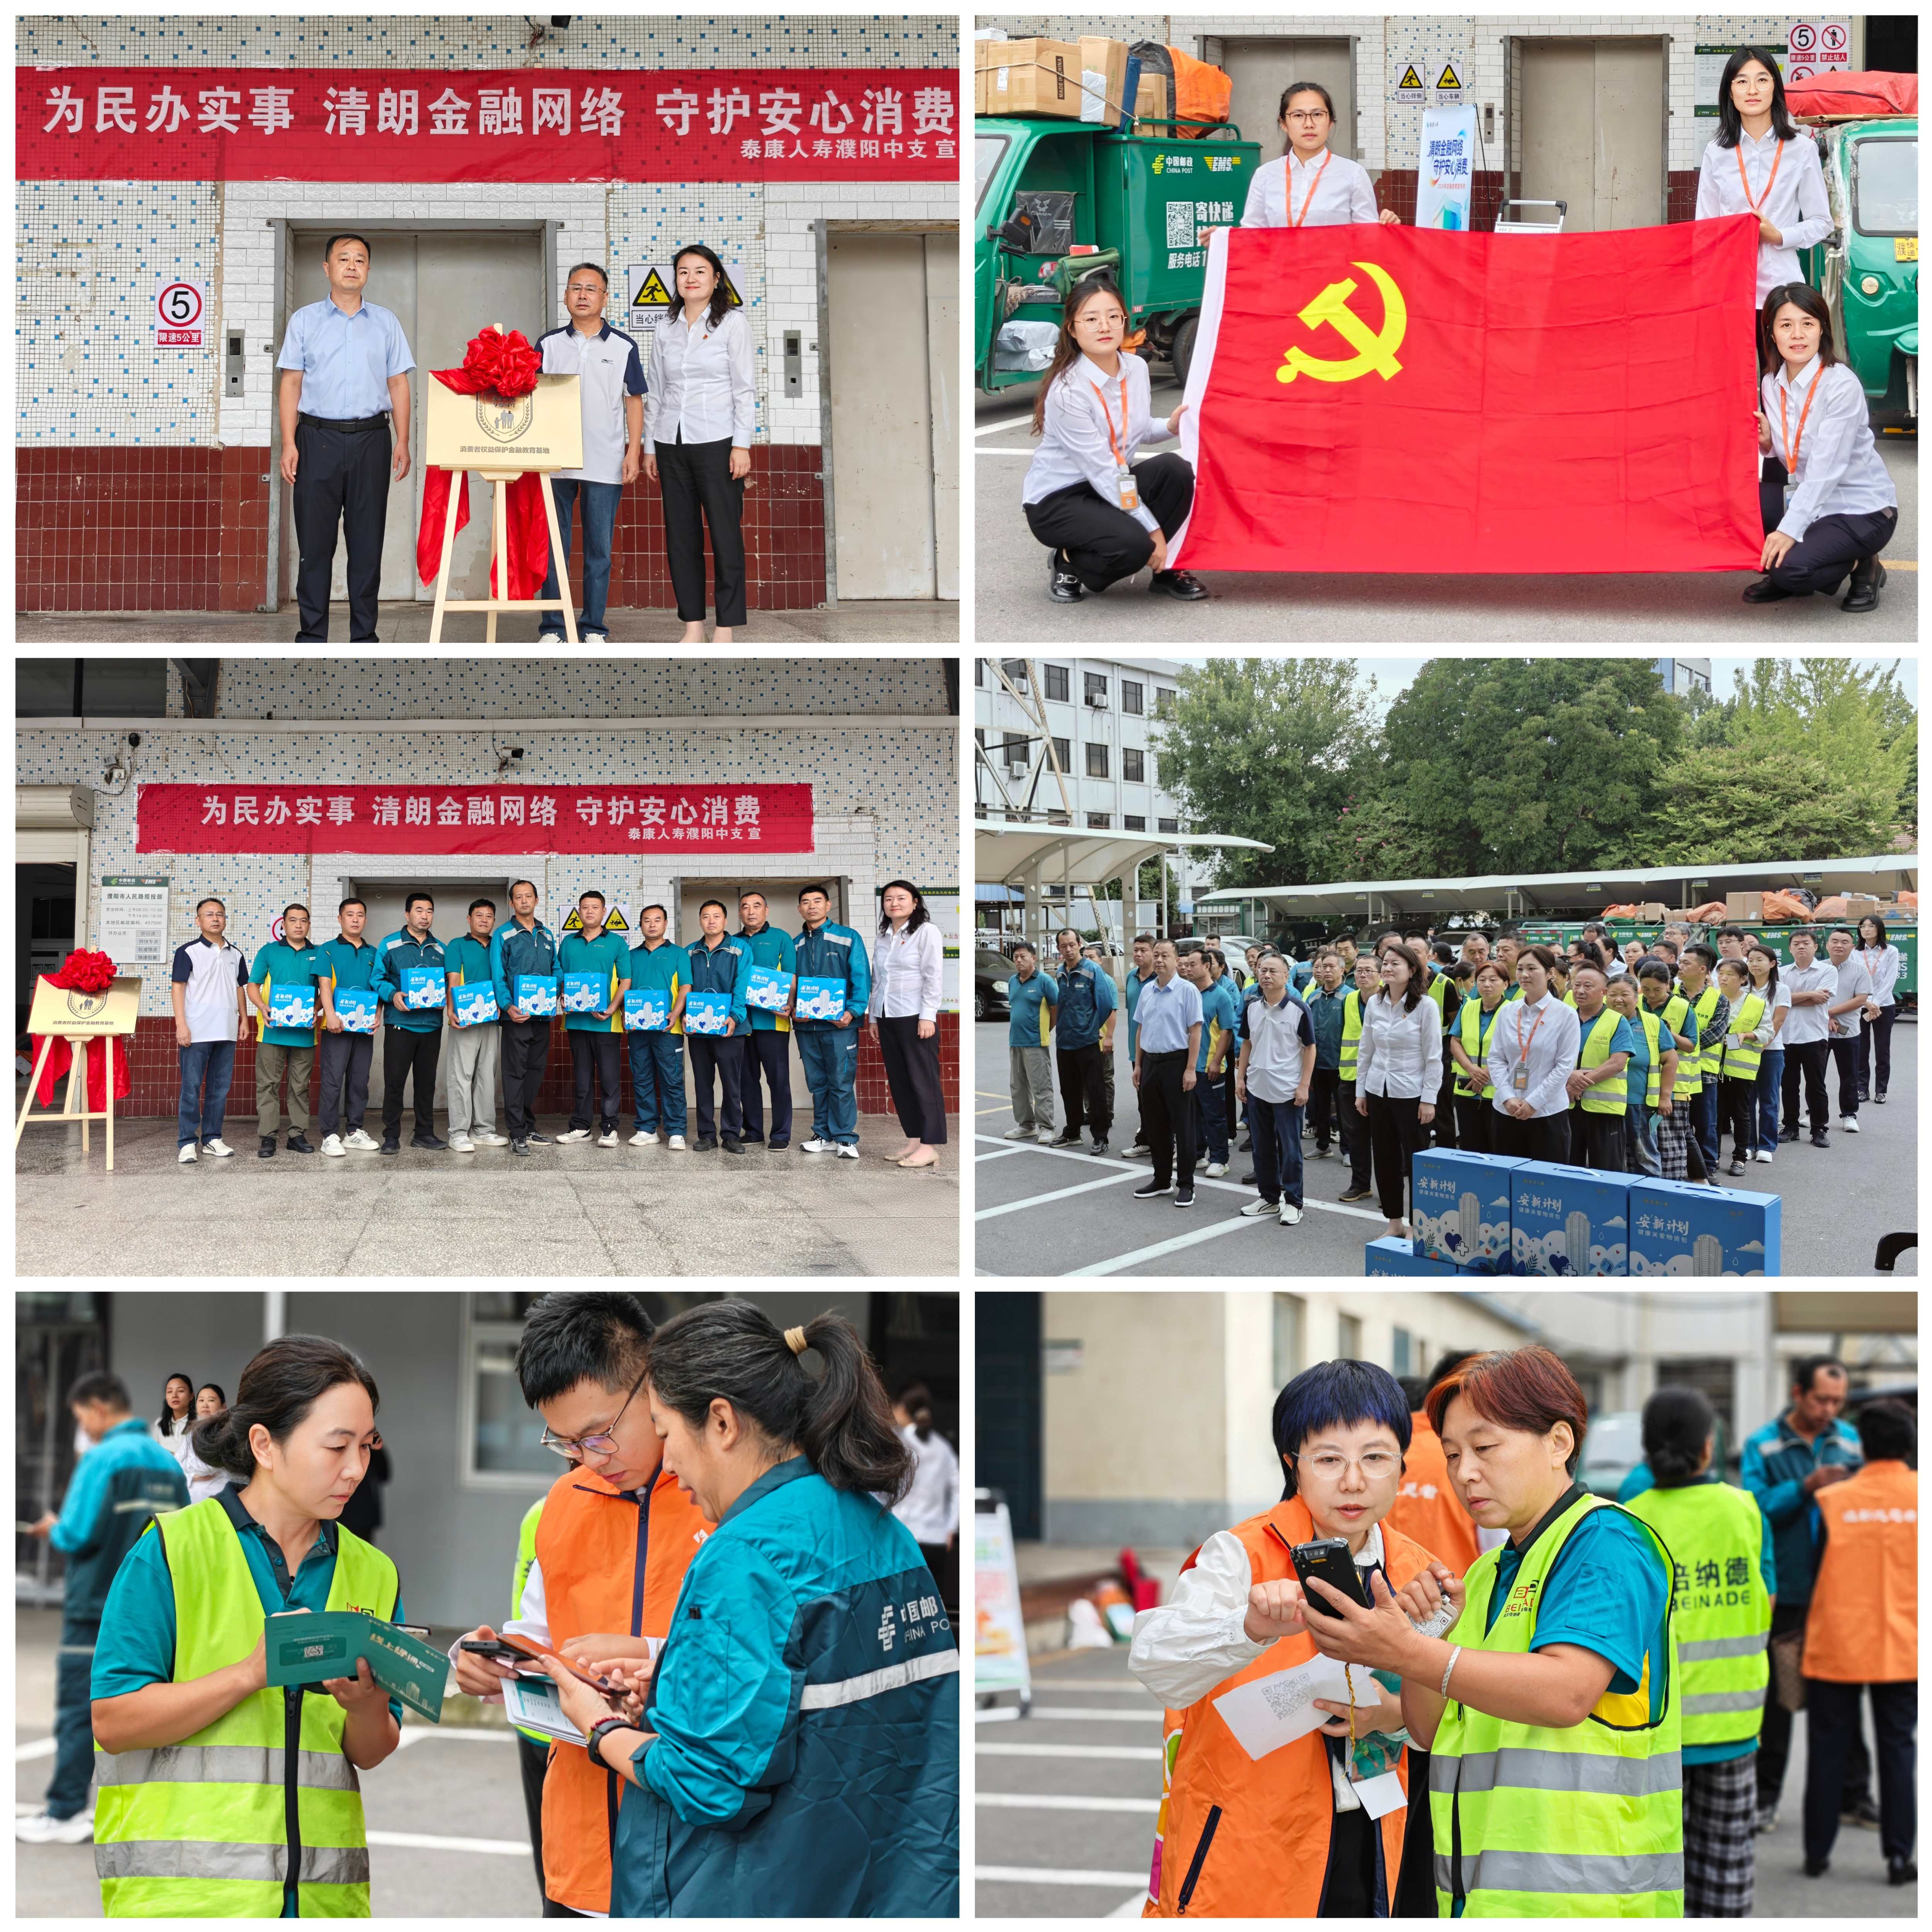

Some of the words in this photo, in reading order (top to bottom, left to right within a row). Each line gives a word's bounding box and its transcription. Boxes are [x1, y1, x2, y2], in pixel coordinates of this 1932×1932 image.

[1798, 29, 1809, 47] 5
[43, 85, 294, 135] 为民办实事
[323, 87, 625, 136] 清朗金融网络
[655, 87, 955, 136] 守护安心消费
[740, 139, 928, 158] 泰康人寿濮阳中支
[935, 139, 956, 158] 宣
[1427, 139, 1464, 159] 清朗金融网络
[1166, 156, 1193, 167] 中国邮政
[1212, 156, 1232, 172] EMS
[1434, 158, 1469, 178] 守护安心消费
[1195, 201, 1234, 222] 寄快递
[1167, 252, 1200, 269] 服务电话
[171, 291, 190, 319] 5
[636, 313, 668, 324] 当心绊
[159, 332, 200, 343] 限速5公里
[460, 446, 550, 454] 消费者权益保护金融教育基地
[201, 795, 355, 826] 为民办实事
[372, 796, 558, 826] 清朗金融网络
[576, 795, 760, 826] 守护安心消费
[628, 828, 743, 840] 泰康人寿濮阳中支
[748, 828, 761, 840] 宣
[1638, 1229, 1687, 1243] 健康关爱物资包
[1672, 1589, 1750, 1612] BEINADE
